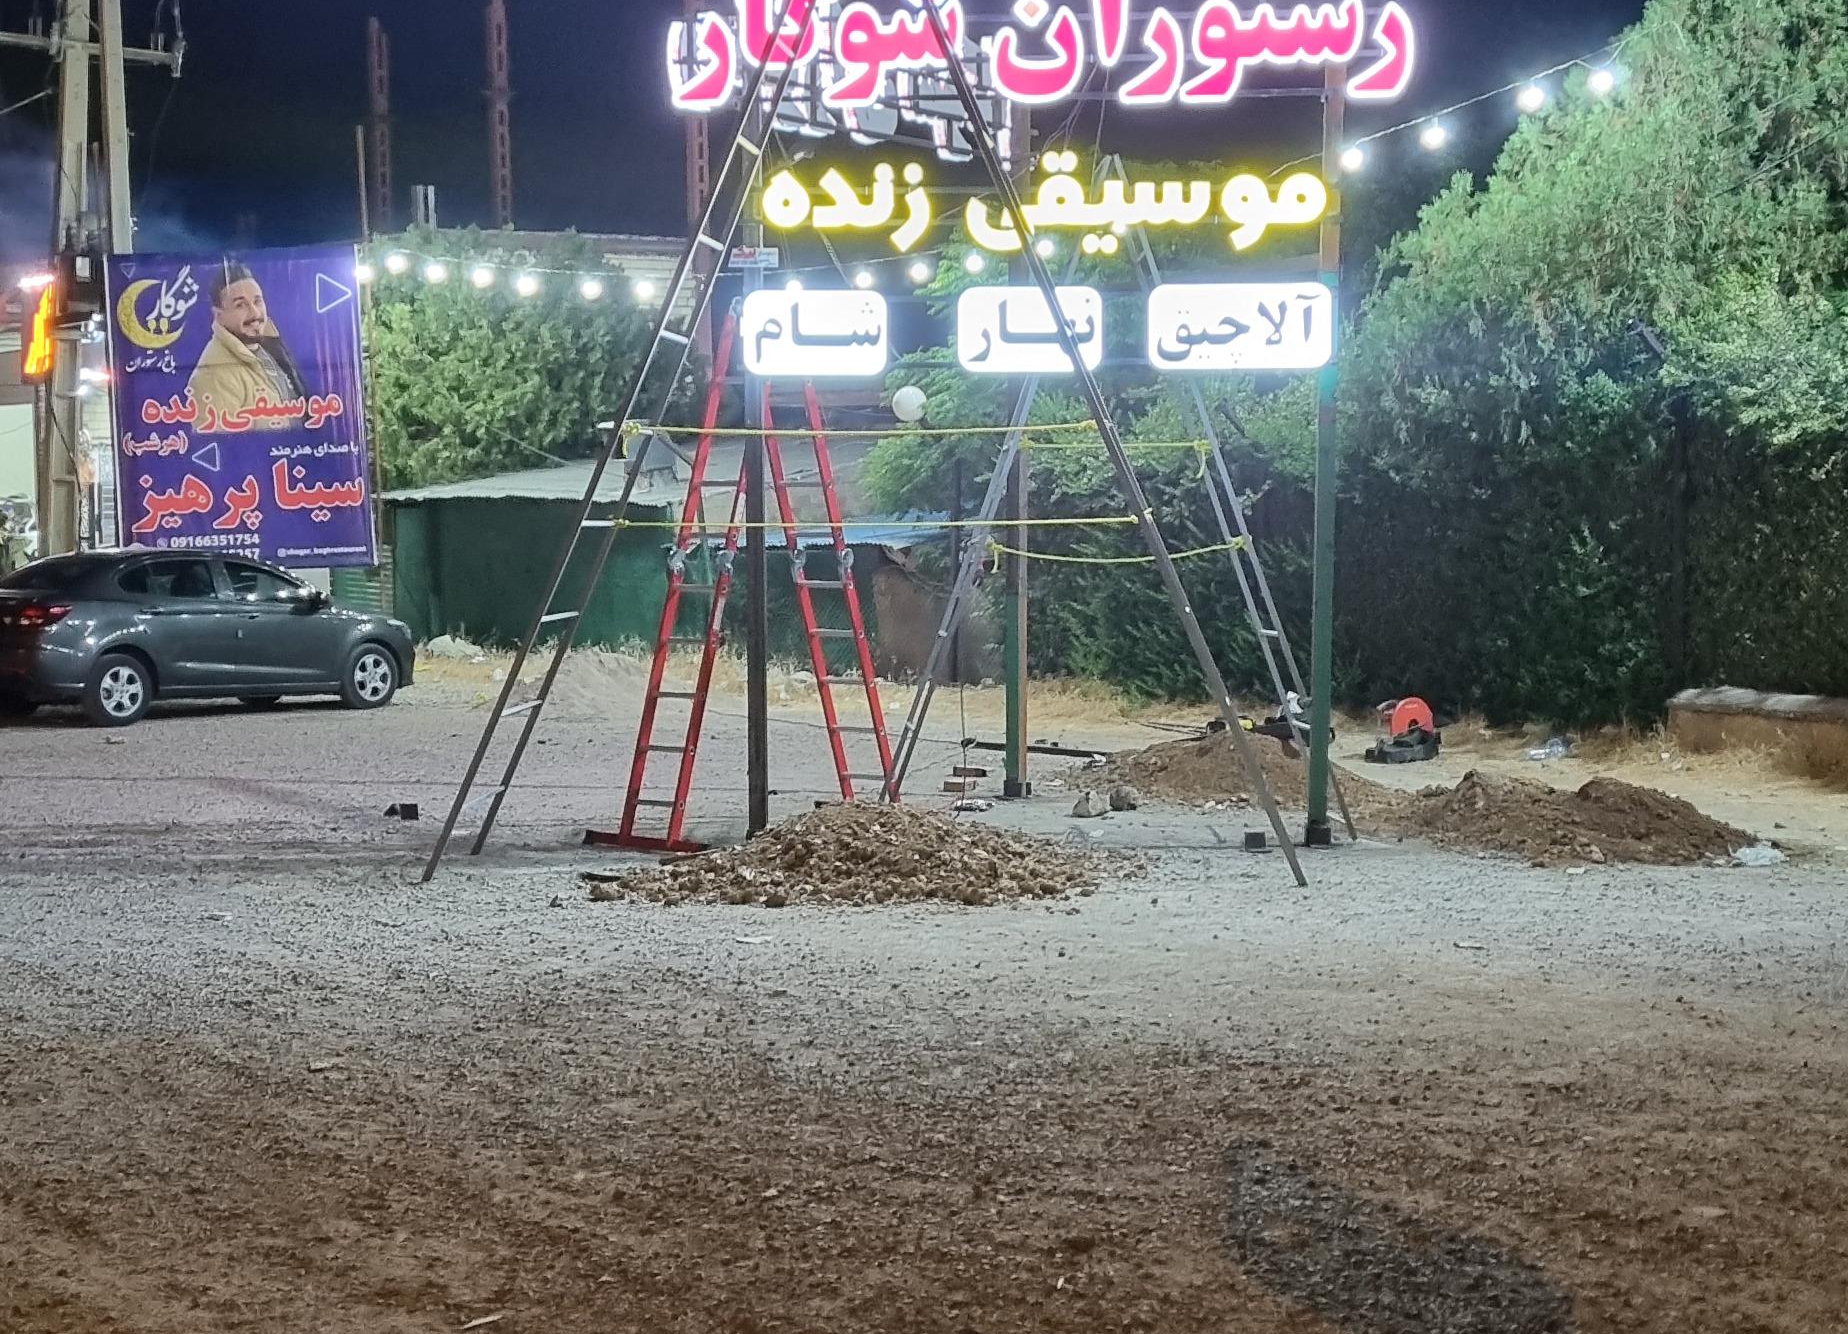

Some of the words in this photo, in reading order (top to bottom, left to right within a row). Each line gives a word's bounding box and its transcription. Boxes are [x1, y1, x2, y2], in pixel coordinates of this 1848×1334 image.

[760, 162, 933, 252] زنده
[965, 149, 1328, 253] موسیقی
[145, 264, 200, 321] شوگار
[754, 300, 882, 364] شام
[1156, 293, 1322, 365] آلاچیق
[142, 387, 218, 433] زنده
[221, 386, 343, 433] موسیقی
[269, 444, 312, 458] هنرمند
[313, 442, 349, 458] صدای
[349, 440, 359, 455] با
[272, 458, 365, 522] سینا
[170, 533, 260, 548] 09166351754
